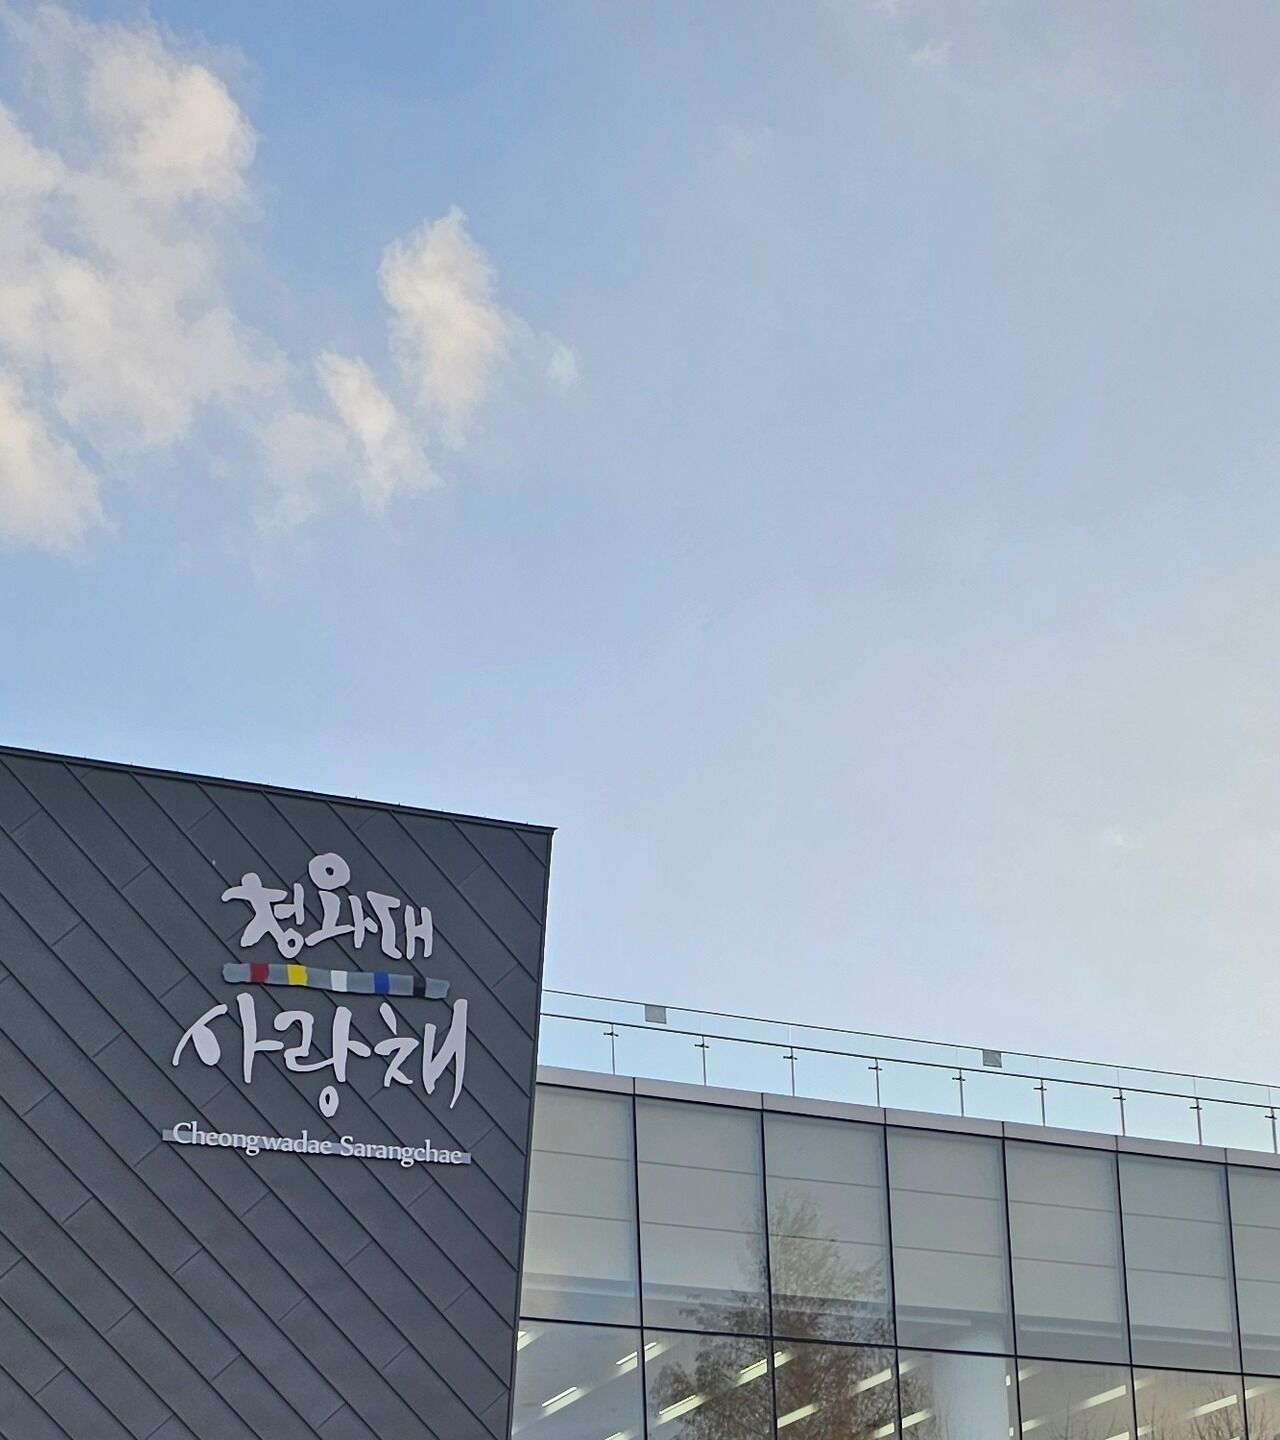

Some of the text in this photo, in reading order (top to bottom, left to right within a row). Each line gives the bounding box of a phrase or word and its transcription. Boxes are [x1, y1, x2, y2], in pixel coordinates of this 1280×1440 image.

[221, 852, 433, 960] 청와대
[172, 992, 468, 1118] 사랑채
[172, 1121, 463, 1167] Cheongwadae Sarangchae
